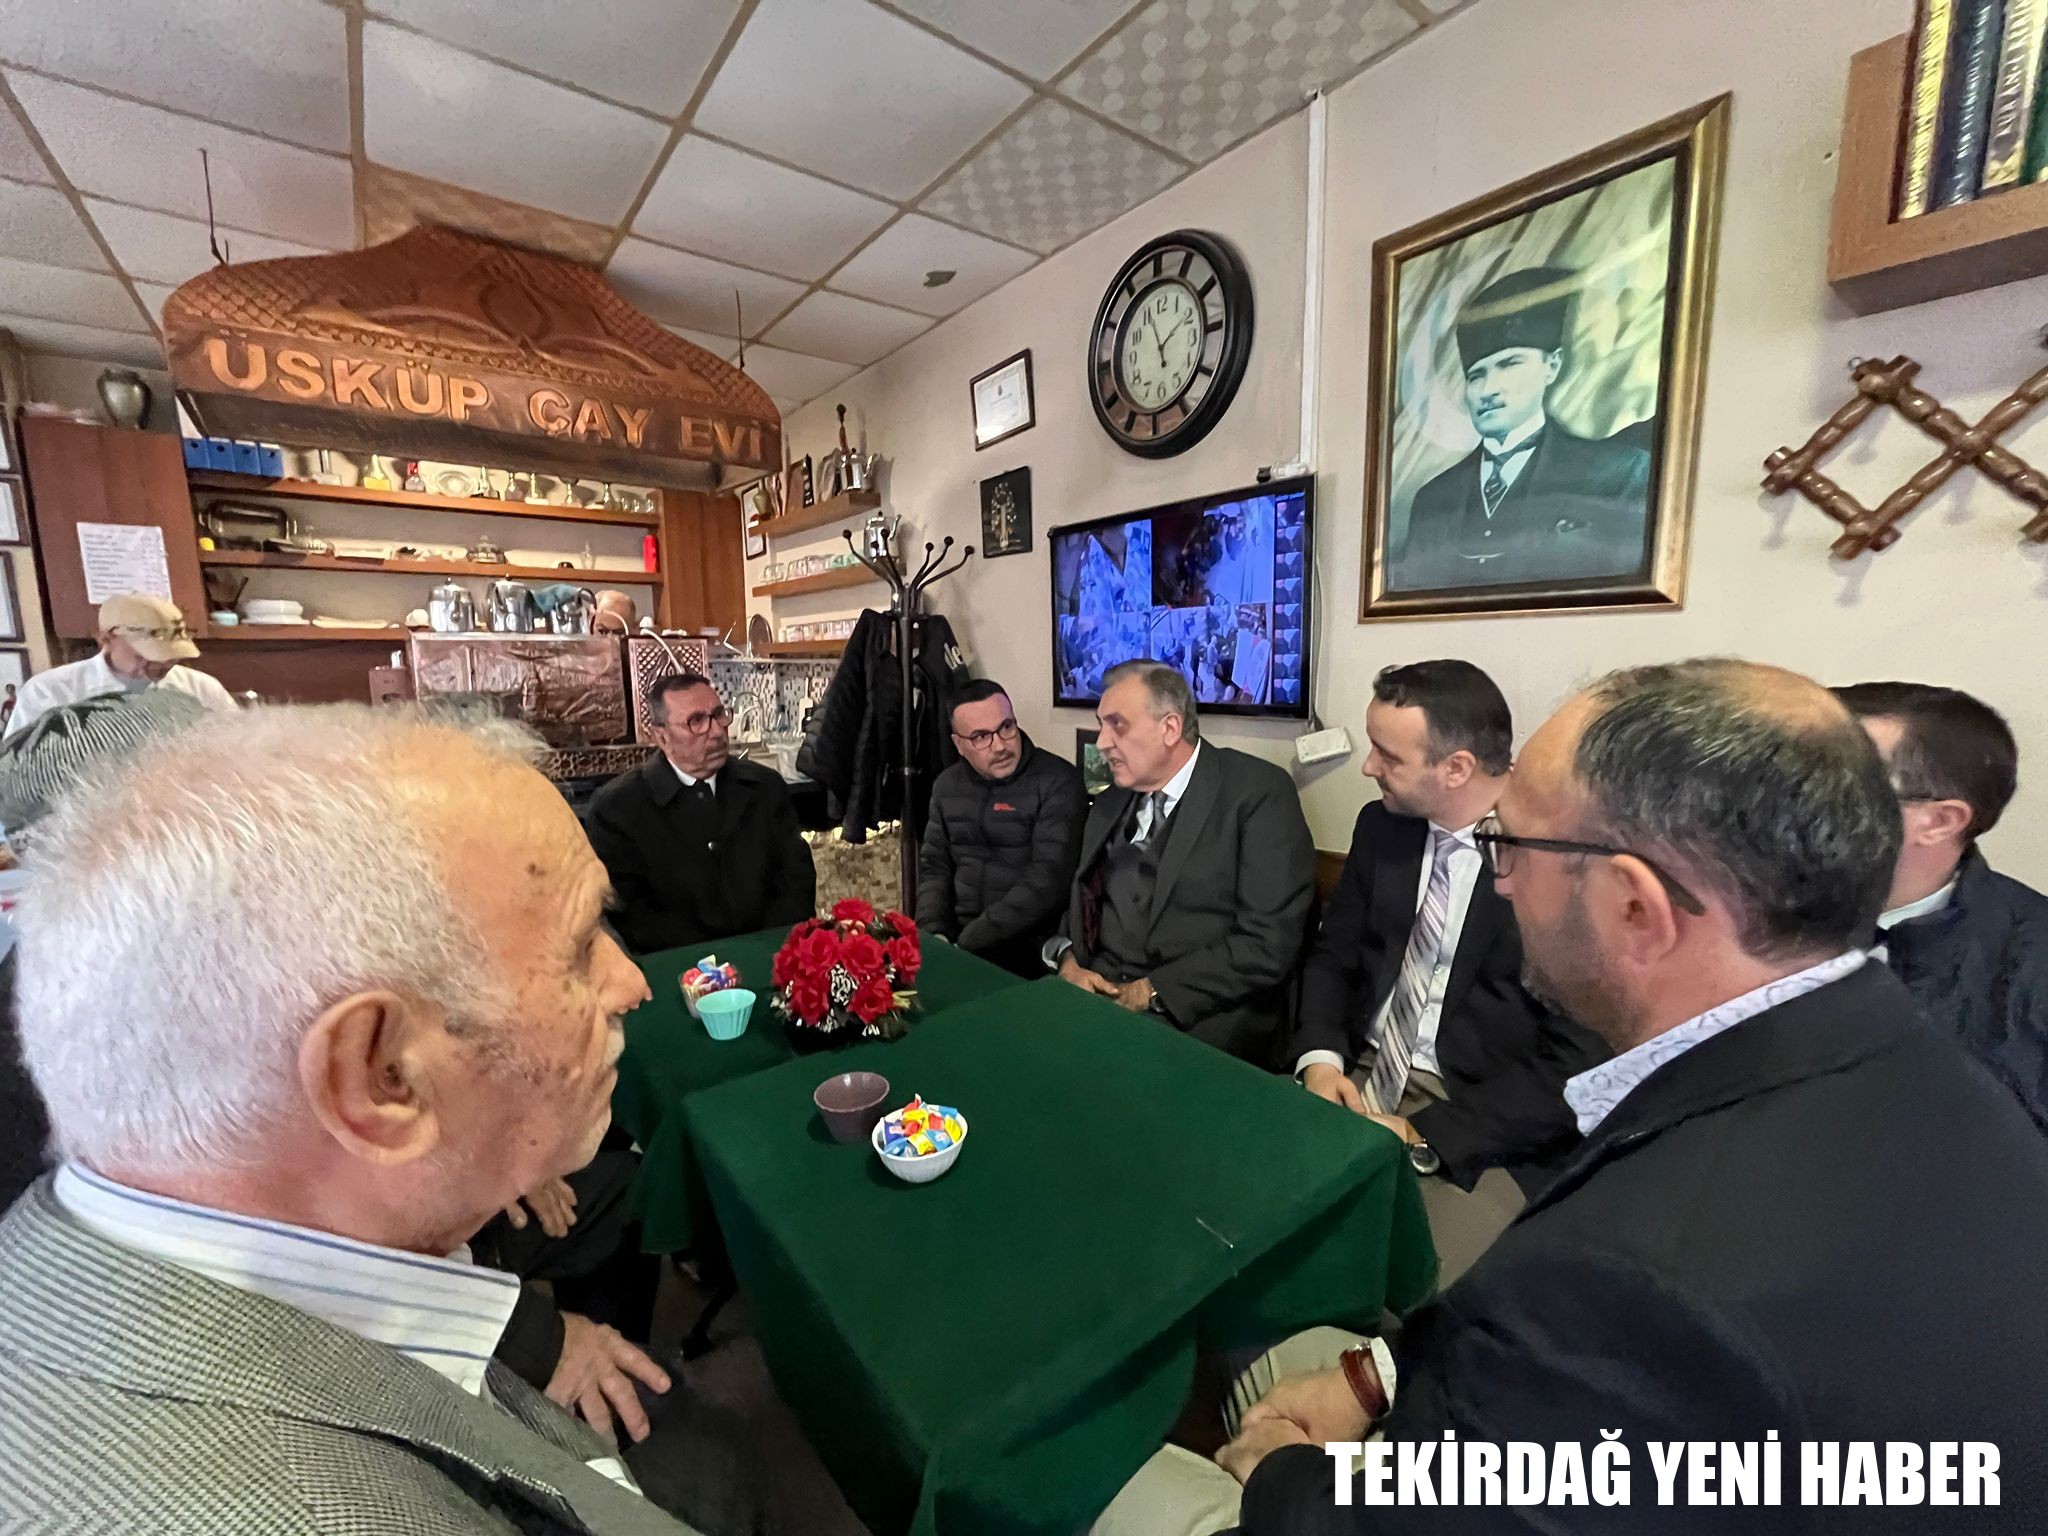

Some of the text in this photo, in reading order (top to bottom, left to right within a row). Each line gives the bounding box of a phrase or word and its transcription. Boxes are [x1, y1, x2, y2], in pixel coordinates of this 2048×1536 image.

[1157, 295, 1167, 315] 12
[1143, 307, 1152, 326] 11
[1184, 307, 1193, 325] 2
[1132, 327, 1142, 346] 10
[1129, 350, 1137, 366] 9
[1132, 369, 1141, 385] 8
[204, 329, 762, 462] ÜSKÜP ÇAY EVİ
[1143, 381, 1152, 401] 7
[1157, 381, 1166, 399] 6
